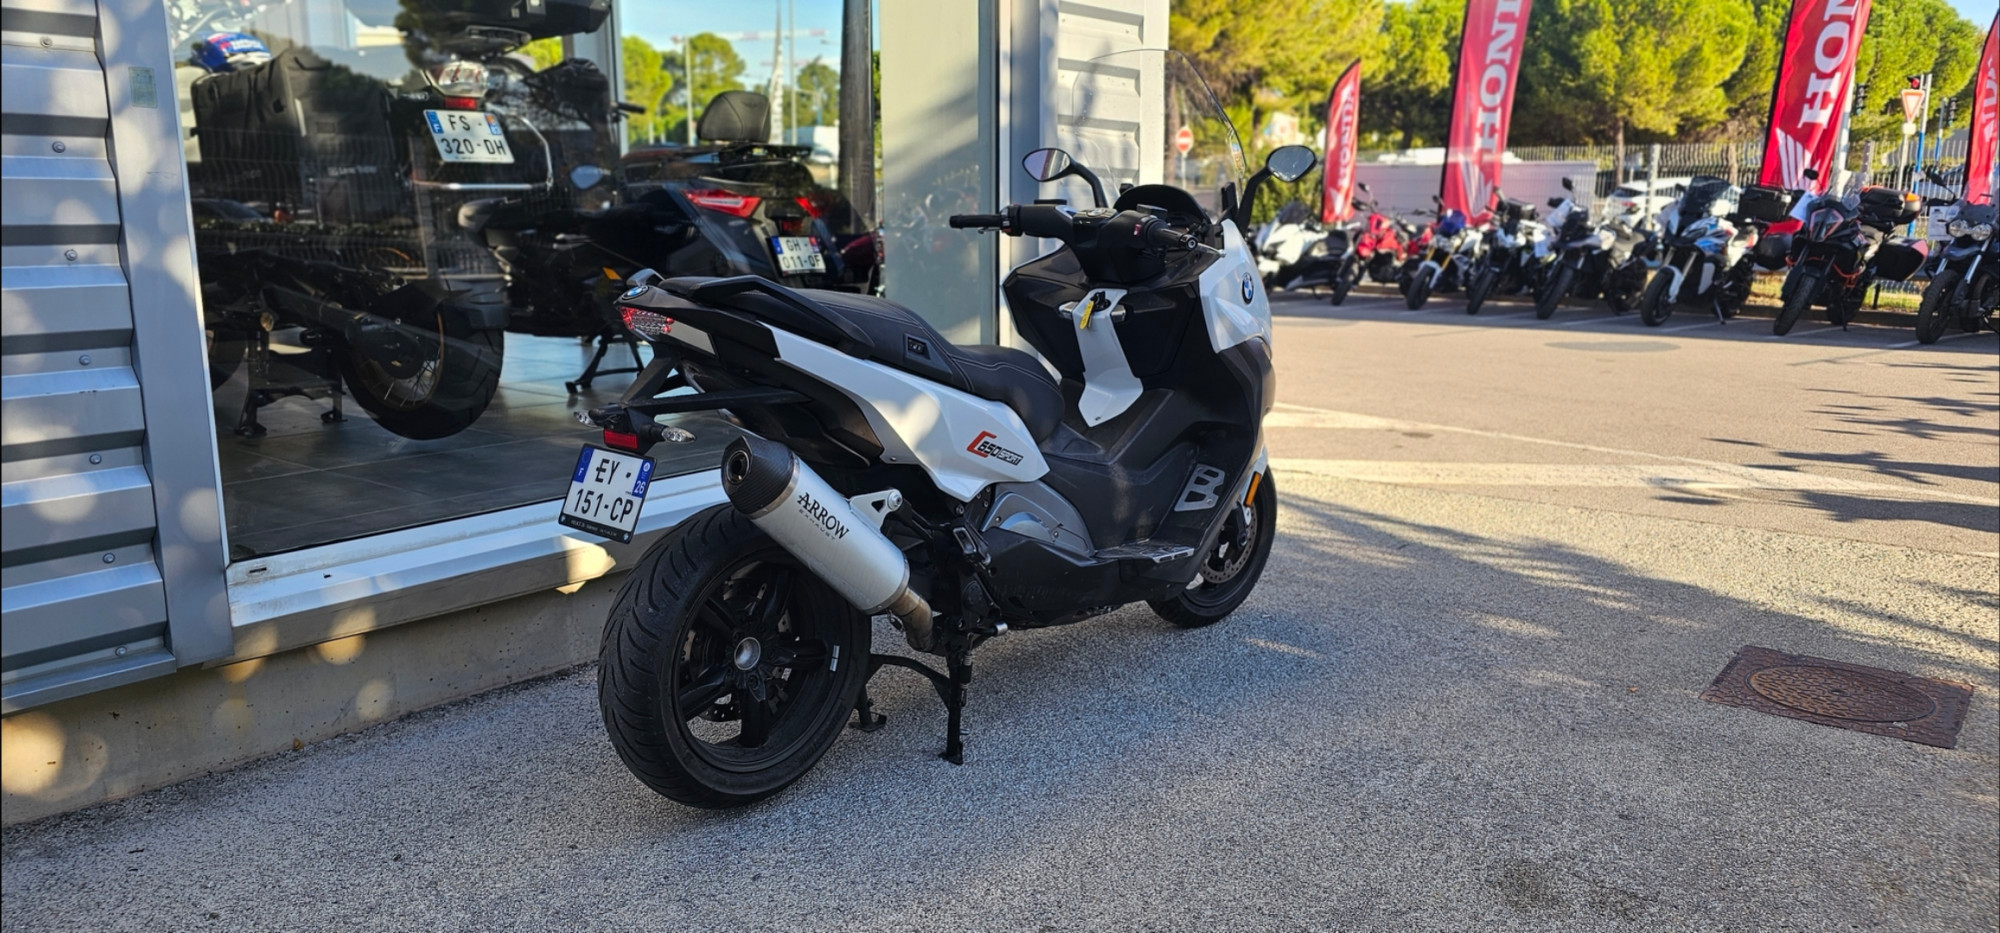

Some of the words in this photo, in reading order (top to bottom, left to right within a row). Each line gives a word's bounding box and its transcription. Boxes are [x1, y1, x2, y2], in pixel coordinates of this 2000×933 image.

[447, 114, 471, 132] FS
[440, 138, 507, 156] 320-DH
[594, 458, 620, 485] EY
[633, 480, 647, 495] 26
[574, 488, 634, 524] 151-CP
[796, 491, 850, 540] ARROW
